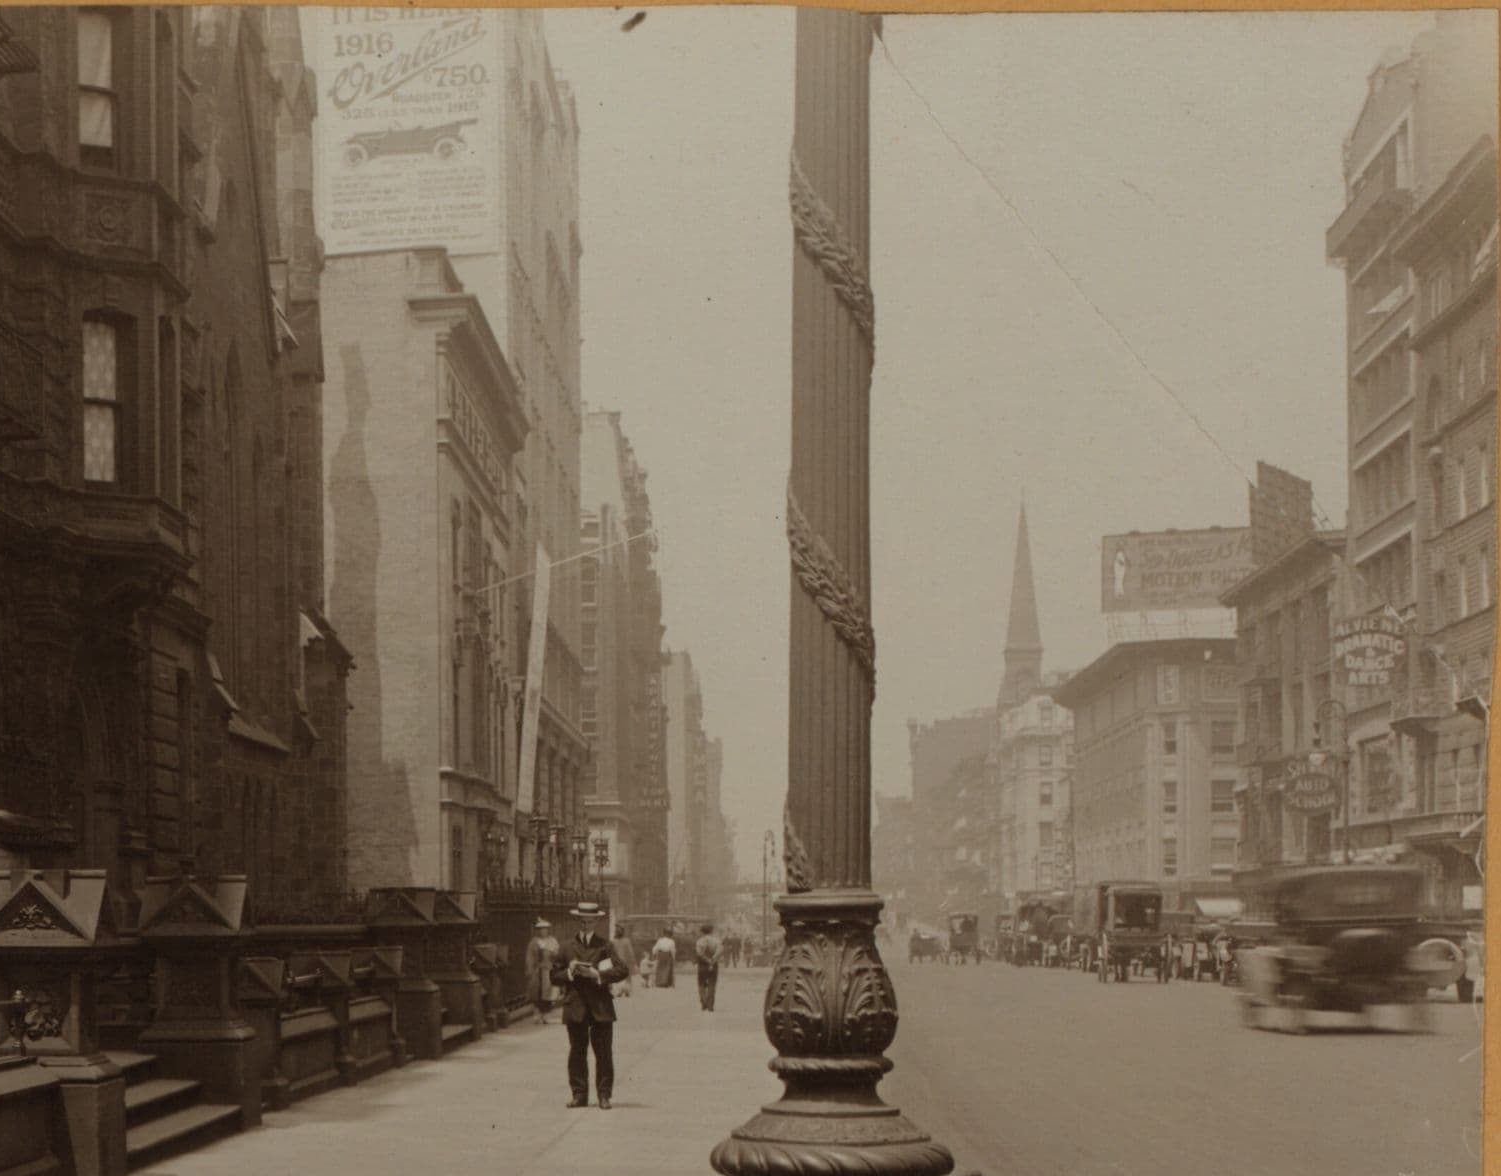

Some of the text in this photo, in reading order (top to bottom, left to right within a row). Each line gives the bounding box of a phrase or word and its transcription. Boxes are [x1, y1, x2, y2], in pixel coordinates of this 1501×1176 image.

[334, 31, 394, 57] 1916
[327, 16, 487, 110] Overland
[1140, 570, 1203, 589] MOTION
[1334, 634, 1405, 659] DRAMATIC
[1345, 654, 1395, 669] DANCE
[1348, 671, 1390, 685] ARTS
[1295, 779, 1330, 792] AUTO
[1284, 791, 1337, 809] SCHOOL
